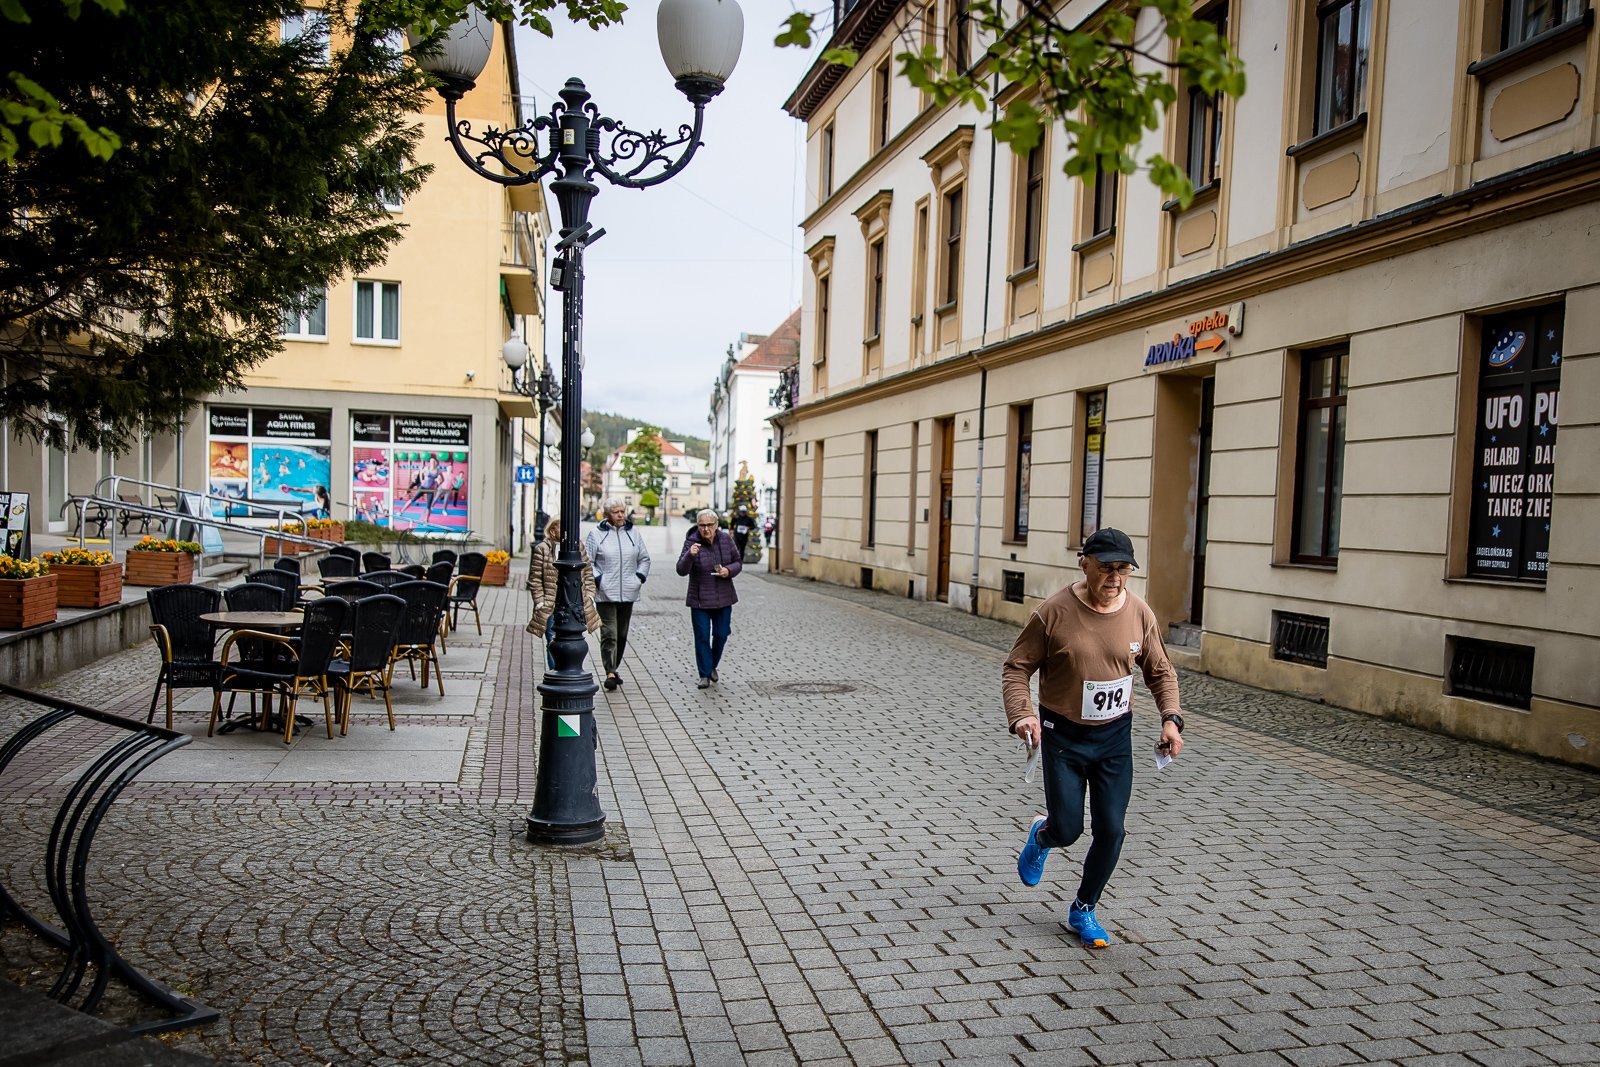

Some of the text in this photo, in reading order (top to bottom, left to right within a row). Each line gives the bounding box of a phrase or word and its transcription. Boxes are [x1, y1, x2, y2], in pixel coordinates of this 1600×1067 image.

[1189, 311, 1227, 337] apteka
[279, 413, 304, 421] SAUNA
[1485, 394, 1523, 430] UFO
[290, 422, 316, 430] FITNESS
[421, 420, 446, 428] FITNESS,
[402, 427, 460, 437] NORDIC WALKING
[1484, 446, 1520, 466] BILARD
[522, 468, 532, 480] it
[1506, 548, 1512, 558] 26
[1538, 562, 1545, 571] 39
[1093, 688, 1123, 711] 919
